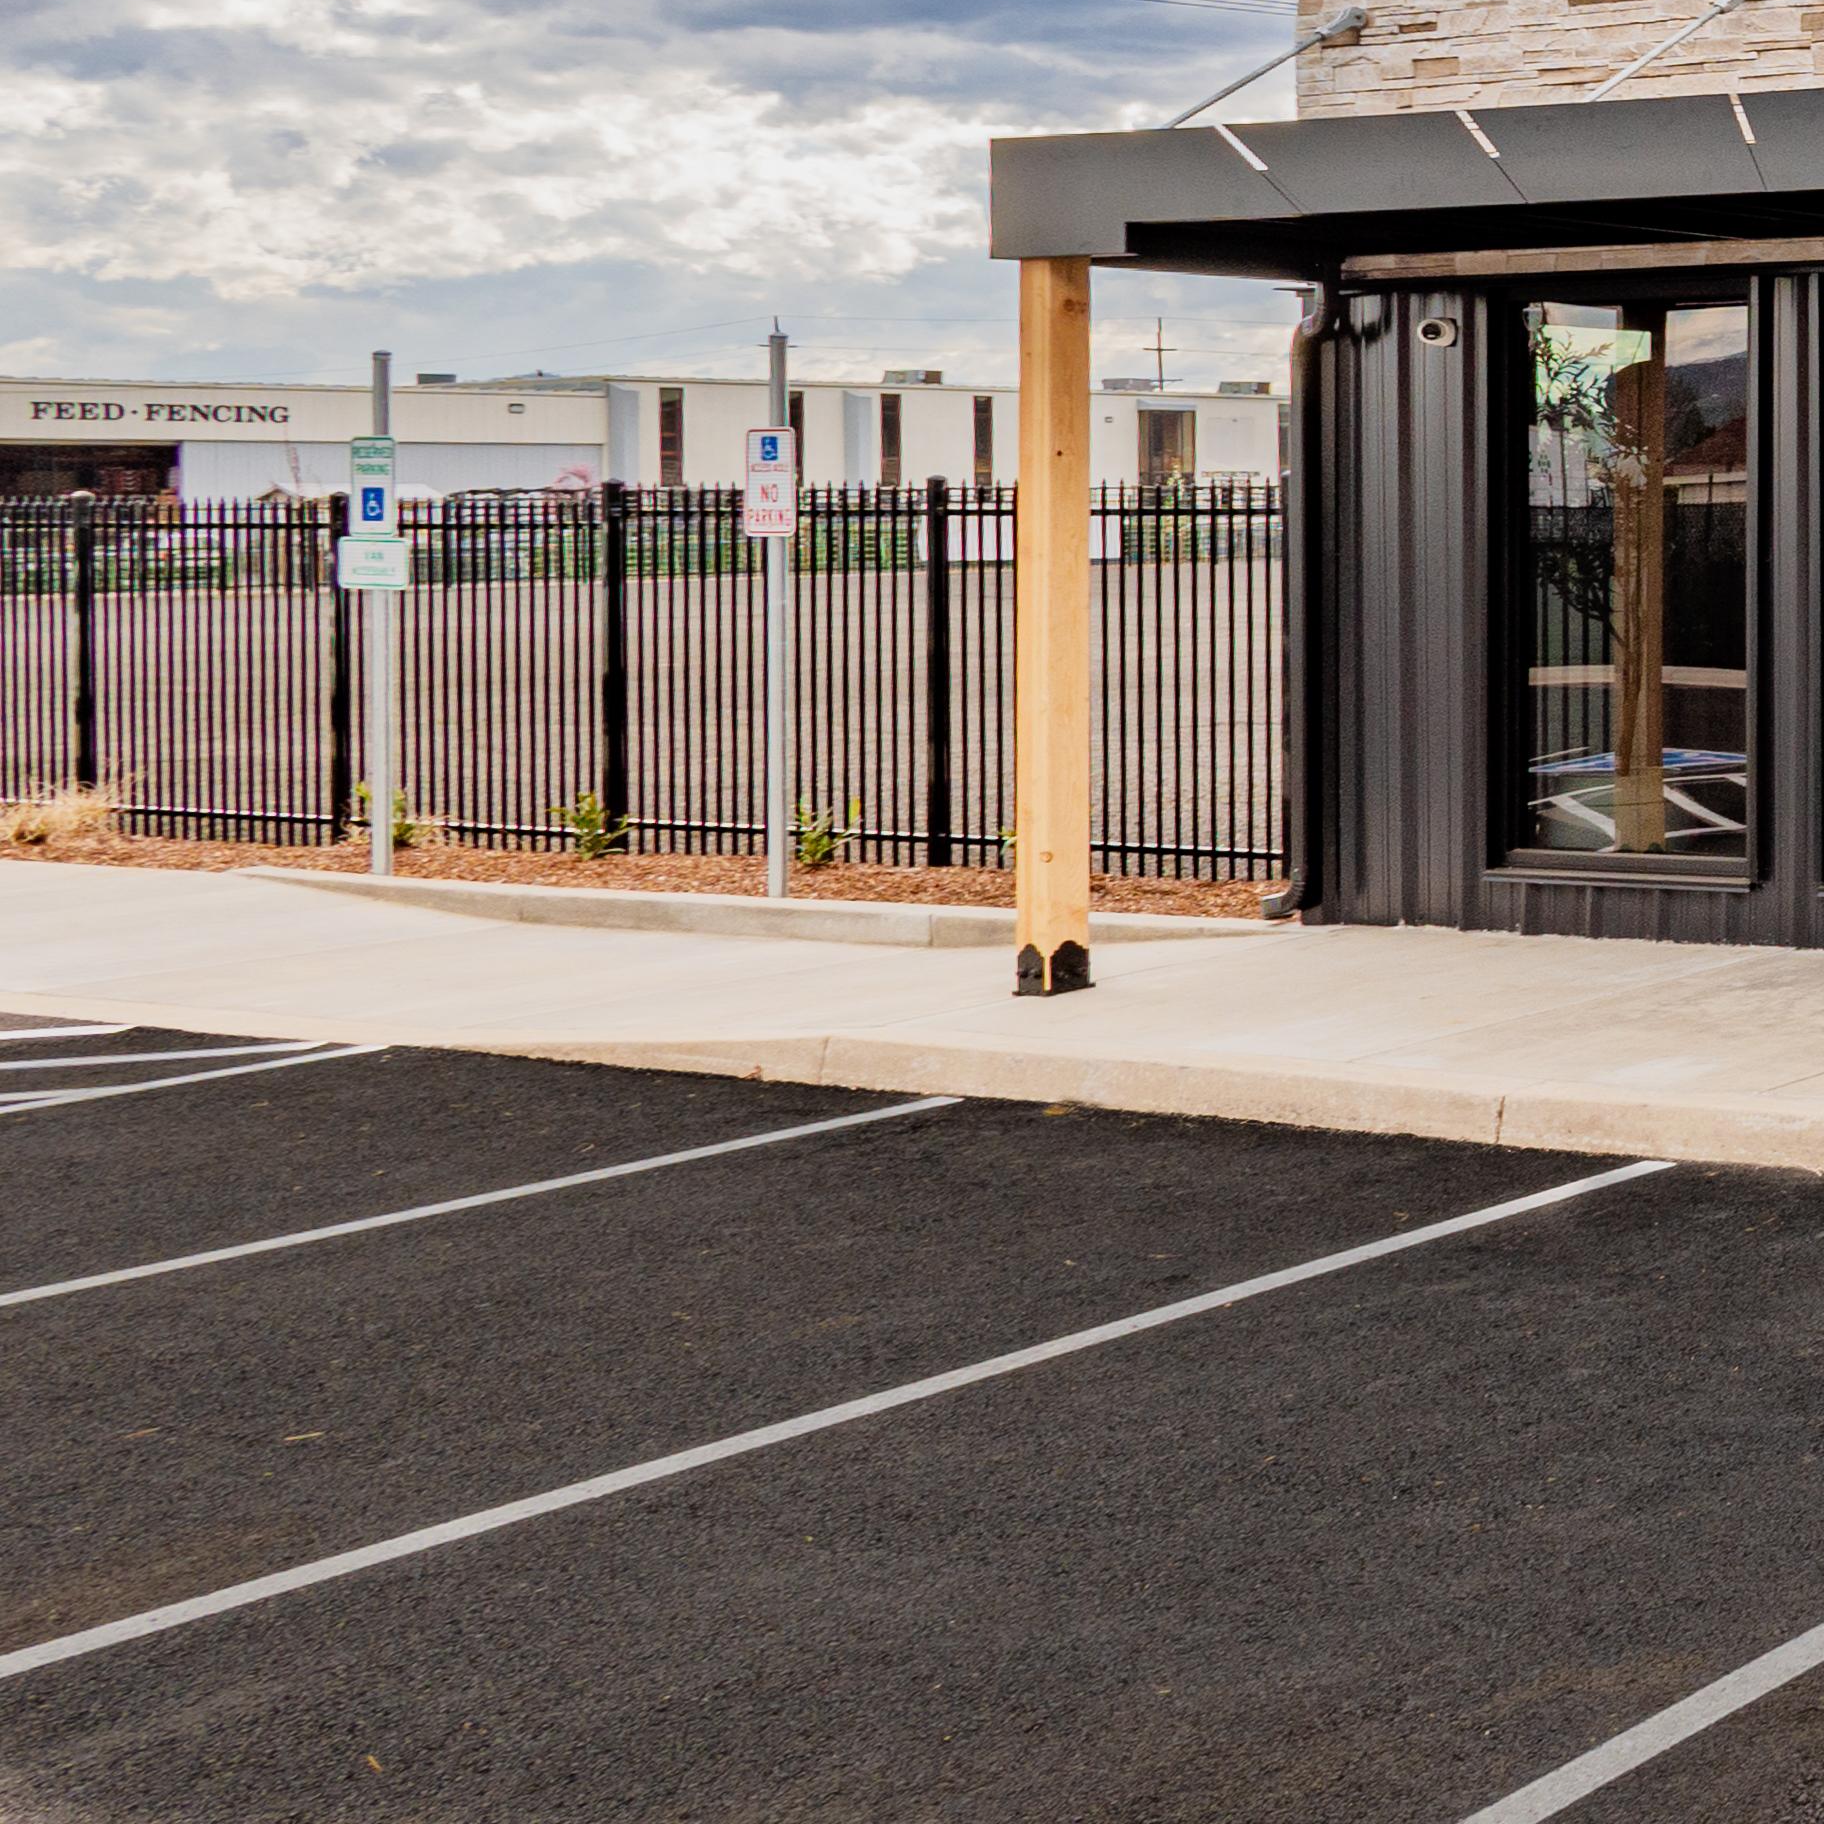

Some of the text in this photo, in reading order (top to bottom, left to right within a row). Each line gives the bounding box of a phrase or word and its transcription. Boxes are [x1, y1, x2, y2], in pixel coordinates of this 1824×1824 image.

[31, 401, 124, 421] FEED
[144, 403, 289, 423] FENCING
[760, 483, 779, 503] NO
[747, 508, 792, 527] PARKING
